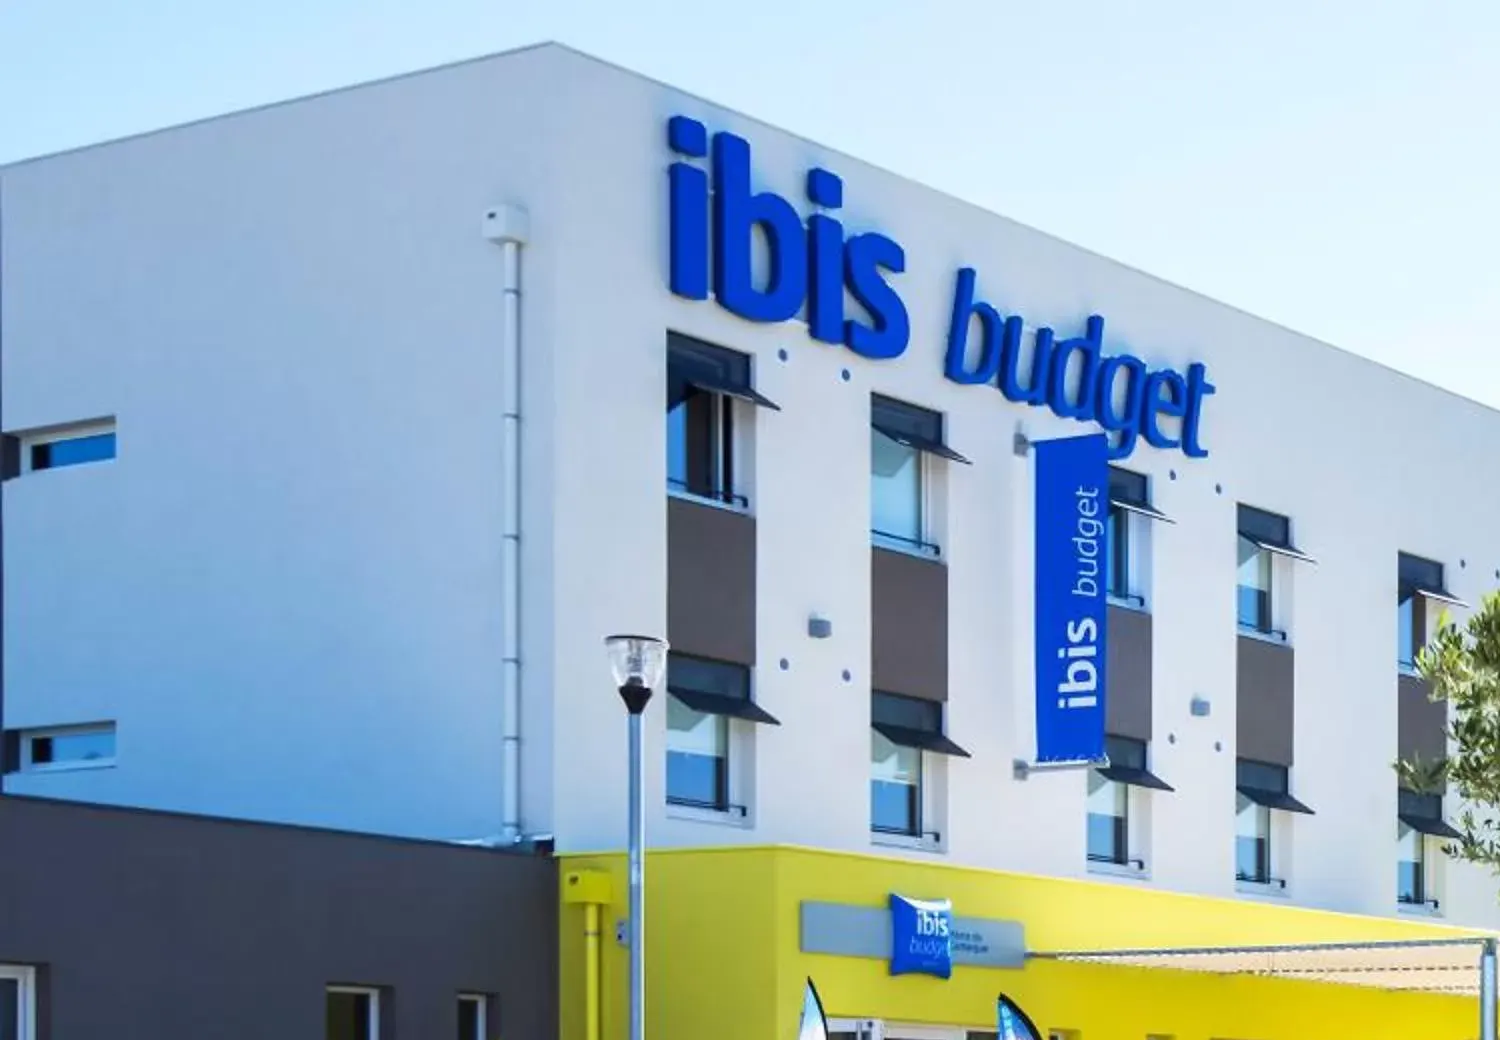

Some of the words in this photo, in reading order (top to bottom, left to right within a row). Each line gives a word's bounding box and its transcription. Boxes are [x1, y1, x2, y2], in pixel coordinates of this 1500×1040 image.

[668, 115, 910, 359] ibis
[944, 267, 1215, 460] budget
[1071, 484, 1105, 597] budget
[1057, 616, 1098, 709] ibis
[917, 909, 949, 937] ibis
